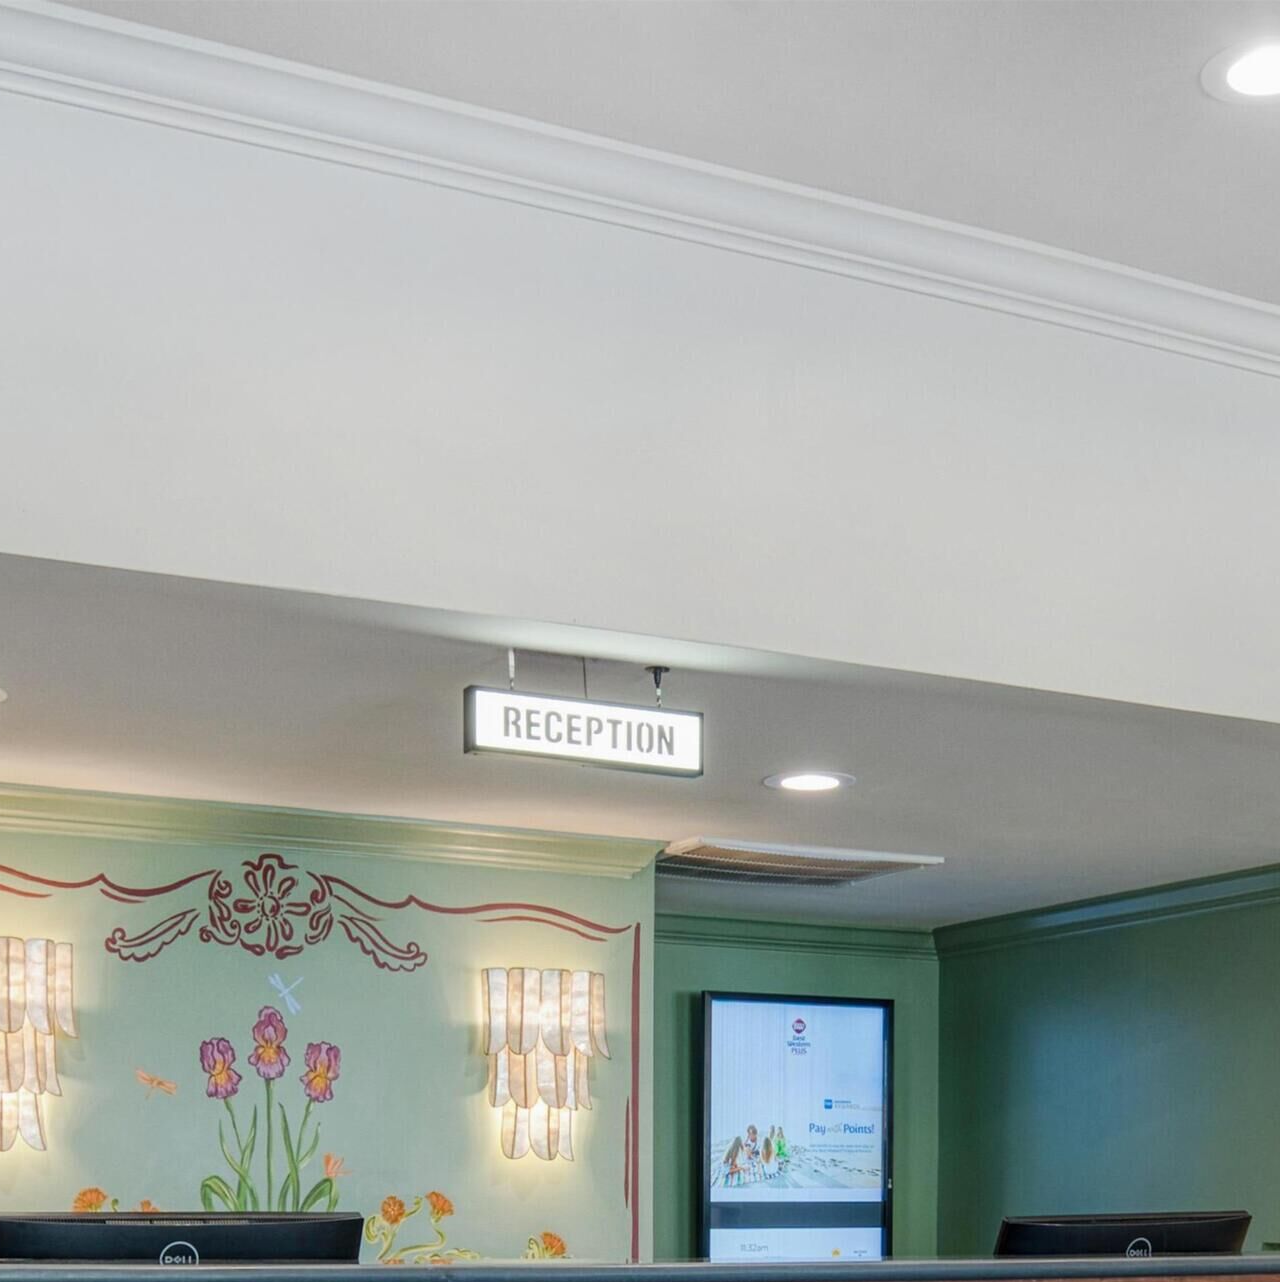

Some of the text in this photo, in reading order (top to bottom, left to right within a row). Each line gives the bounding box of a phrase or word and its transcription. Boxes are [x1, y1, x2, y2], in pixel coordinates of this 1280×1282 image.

[503, 706, 675, 756] RECEPTION
[809, 1123, 826, 1135] Pay
[844, 1123, 874, 1134] Points!
[164, 1255, 192, 1264] DELL
